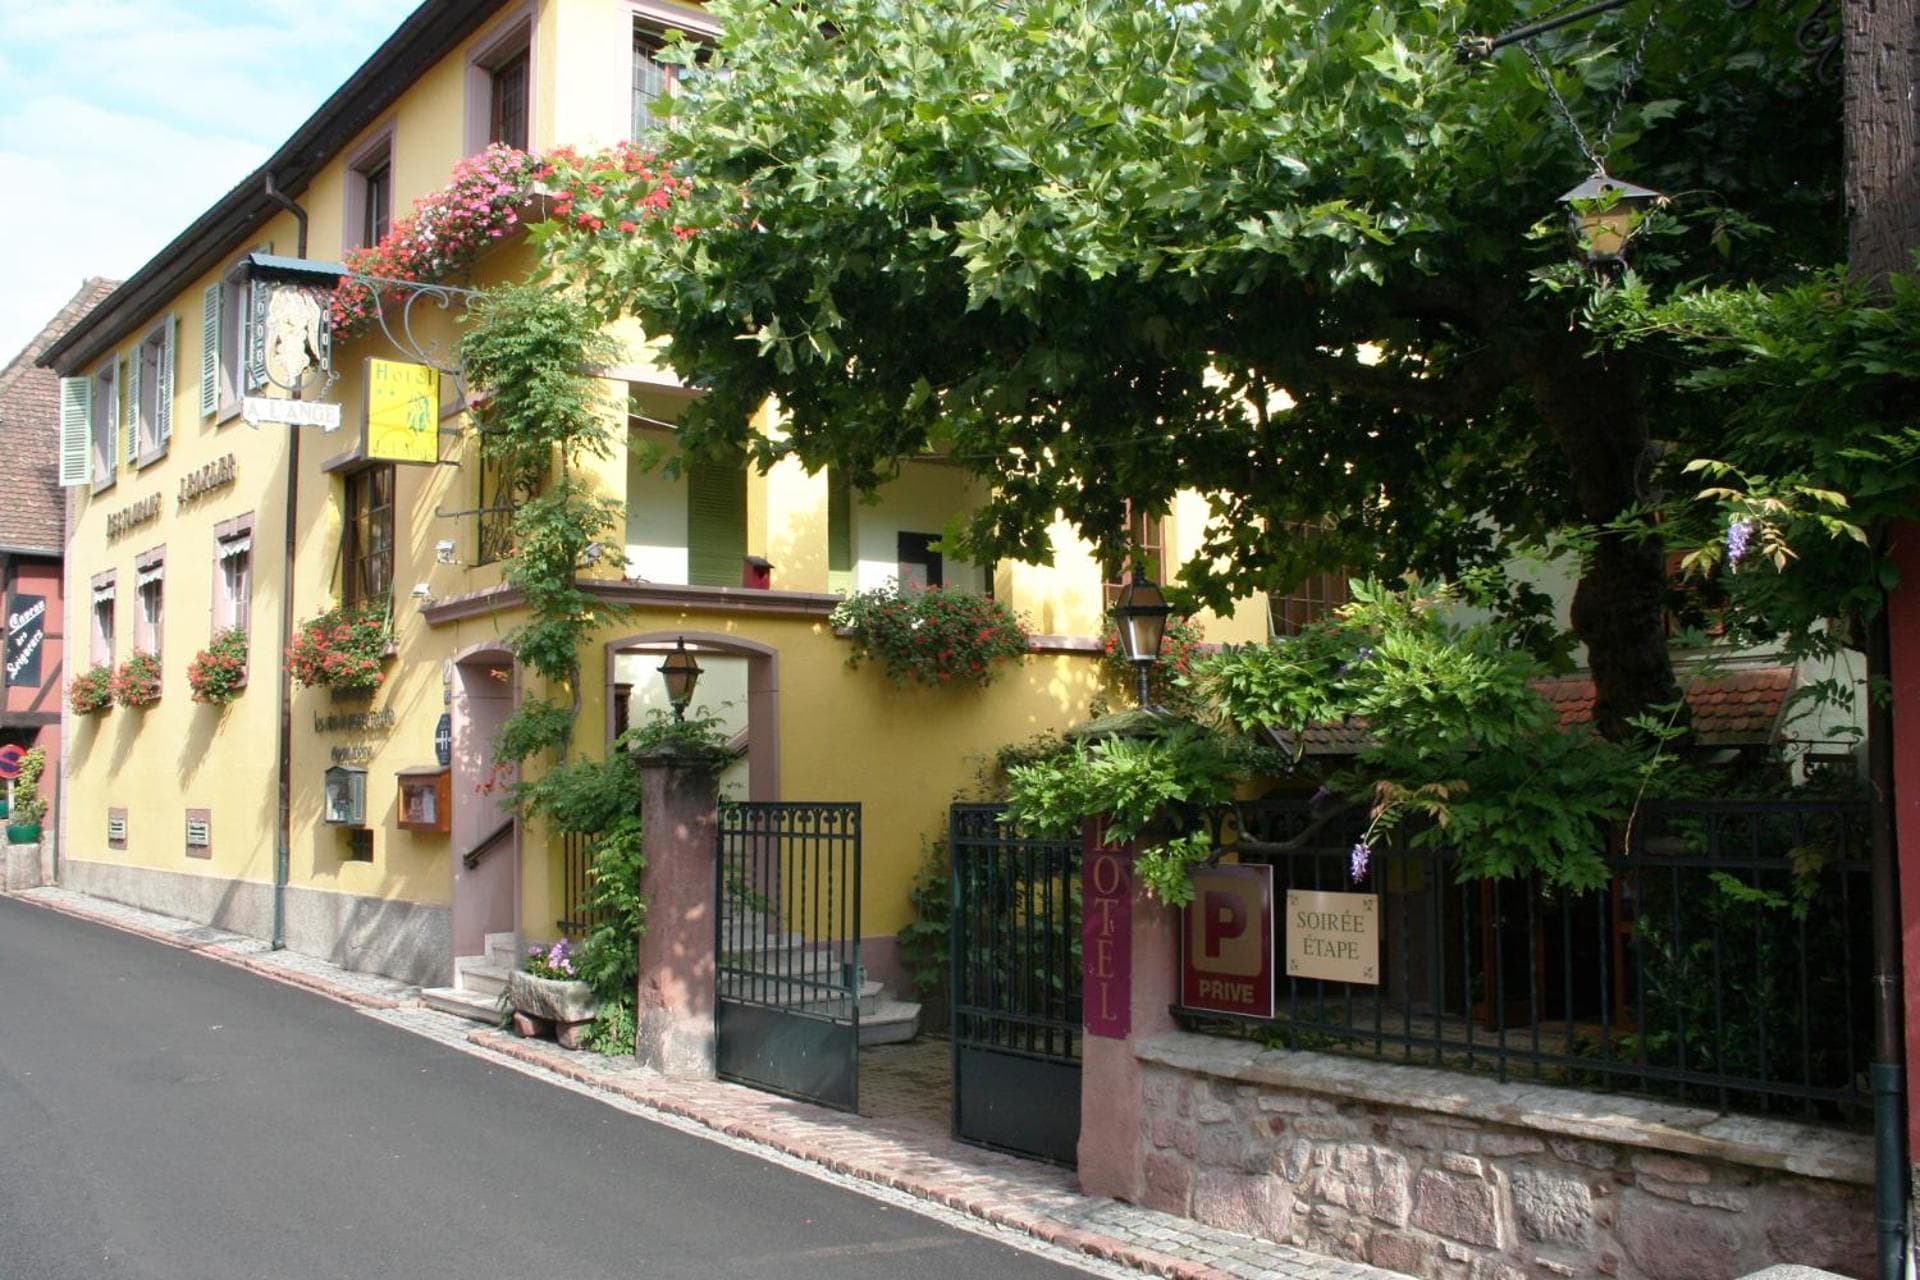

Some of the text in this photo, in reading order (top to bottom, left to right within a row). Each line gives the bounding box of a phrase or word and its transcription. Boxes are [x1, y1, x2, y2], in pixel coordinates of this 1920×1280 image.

[1205, 890, 1247, 959] P
[1296, 909, 1366, 934] SOIRÉE
[1302, 934, 1360, 961] ÉTAPE
[1199, 979, 1255, 1004] PRIVE
